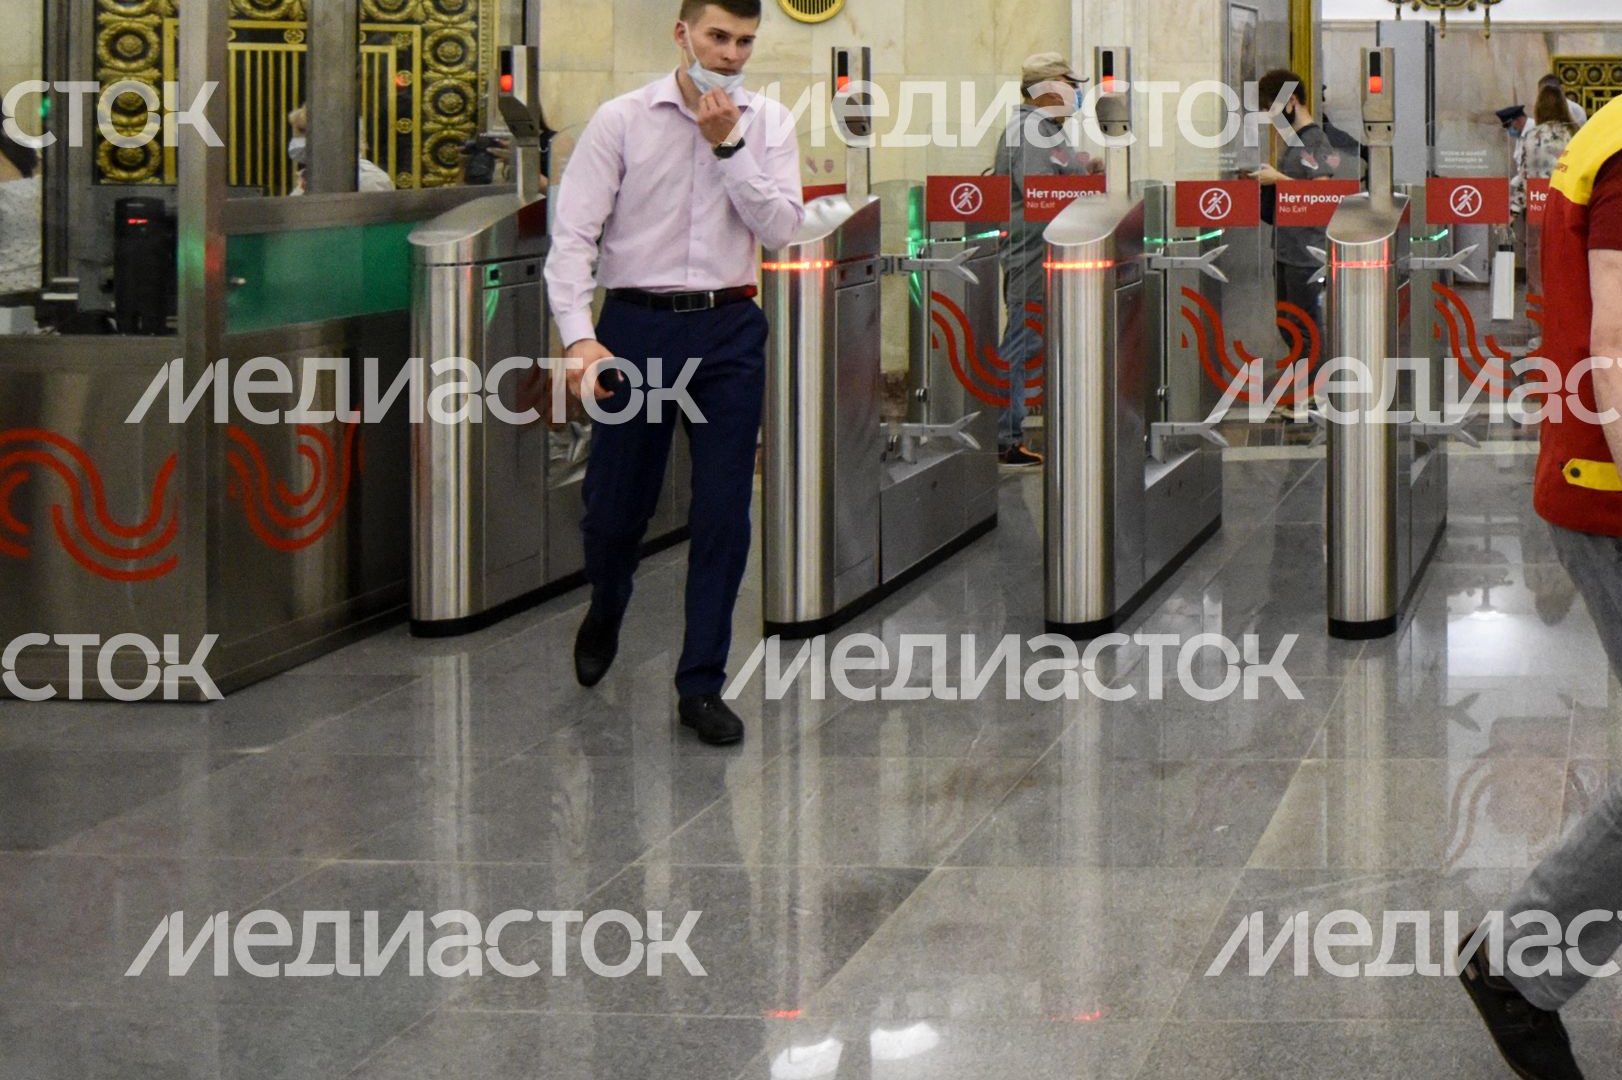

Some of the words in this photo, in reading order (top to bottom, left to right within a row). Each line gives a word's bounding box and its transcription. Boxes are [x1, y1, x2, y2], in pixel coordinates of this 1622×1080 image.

[1026, 187, 1049, 199] Нет
[1279, 192, 1302, 204] Нет
[1303, 194, 1345, 206] прохо
[1530, 191, 1548, 201] Не
